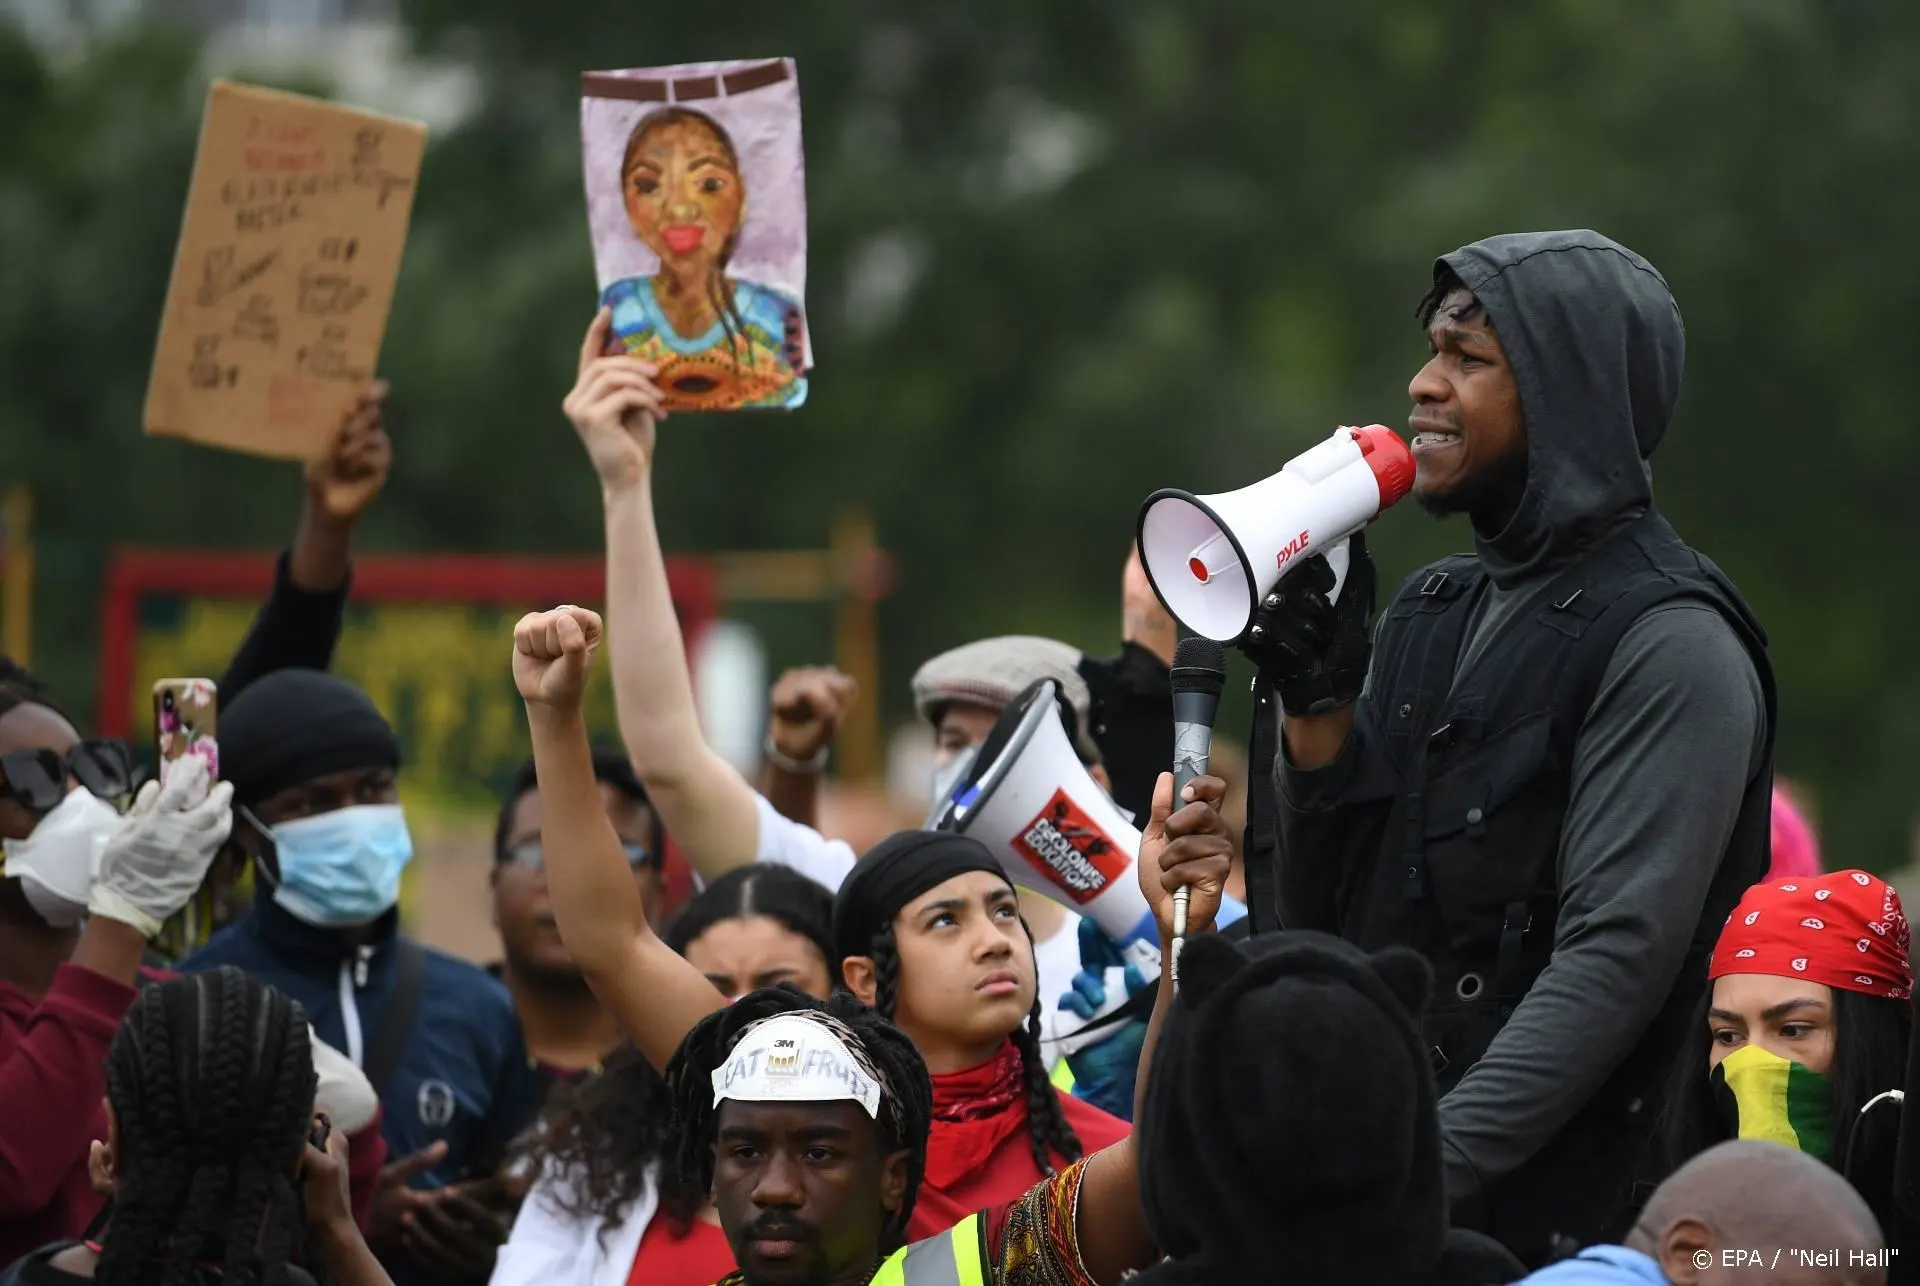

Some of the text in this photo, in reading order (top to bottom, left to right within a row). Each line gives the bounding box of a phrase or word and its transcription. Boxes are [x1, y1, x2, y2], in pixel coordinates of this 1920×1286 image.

[1277, 529, 1309, 569] PYLE
[1024, 828, 1090, 890] EDUCATION
[1035, 818, 1106, 889] DECOLONISE
[774, 1039, 795, 1048] 3M
